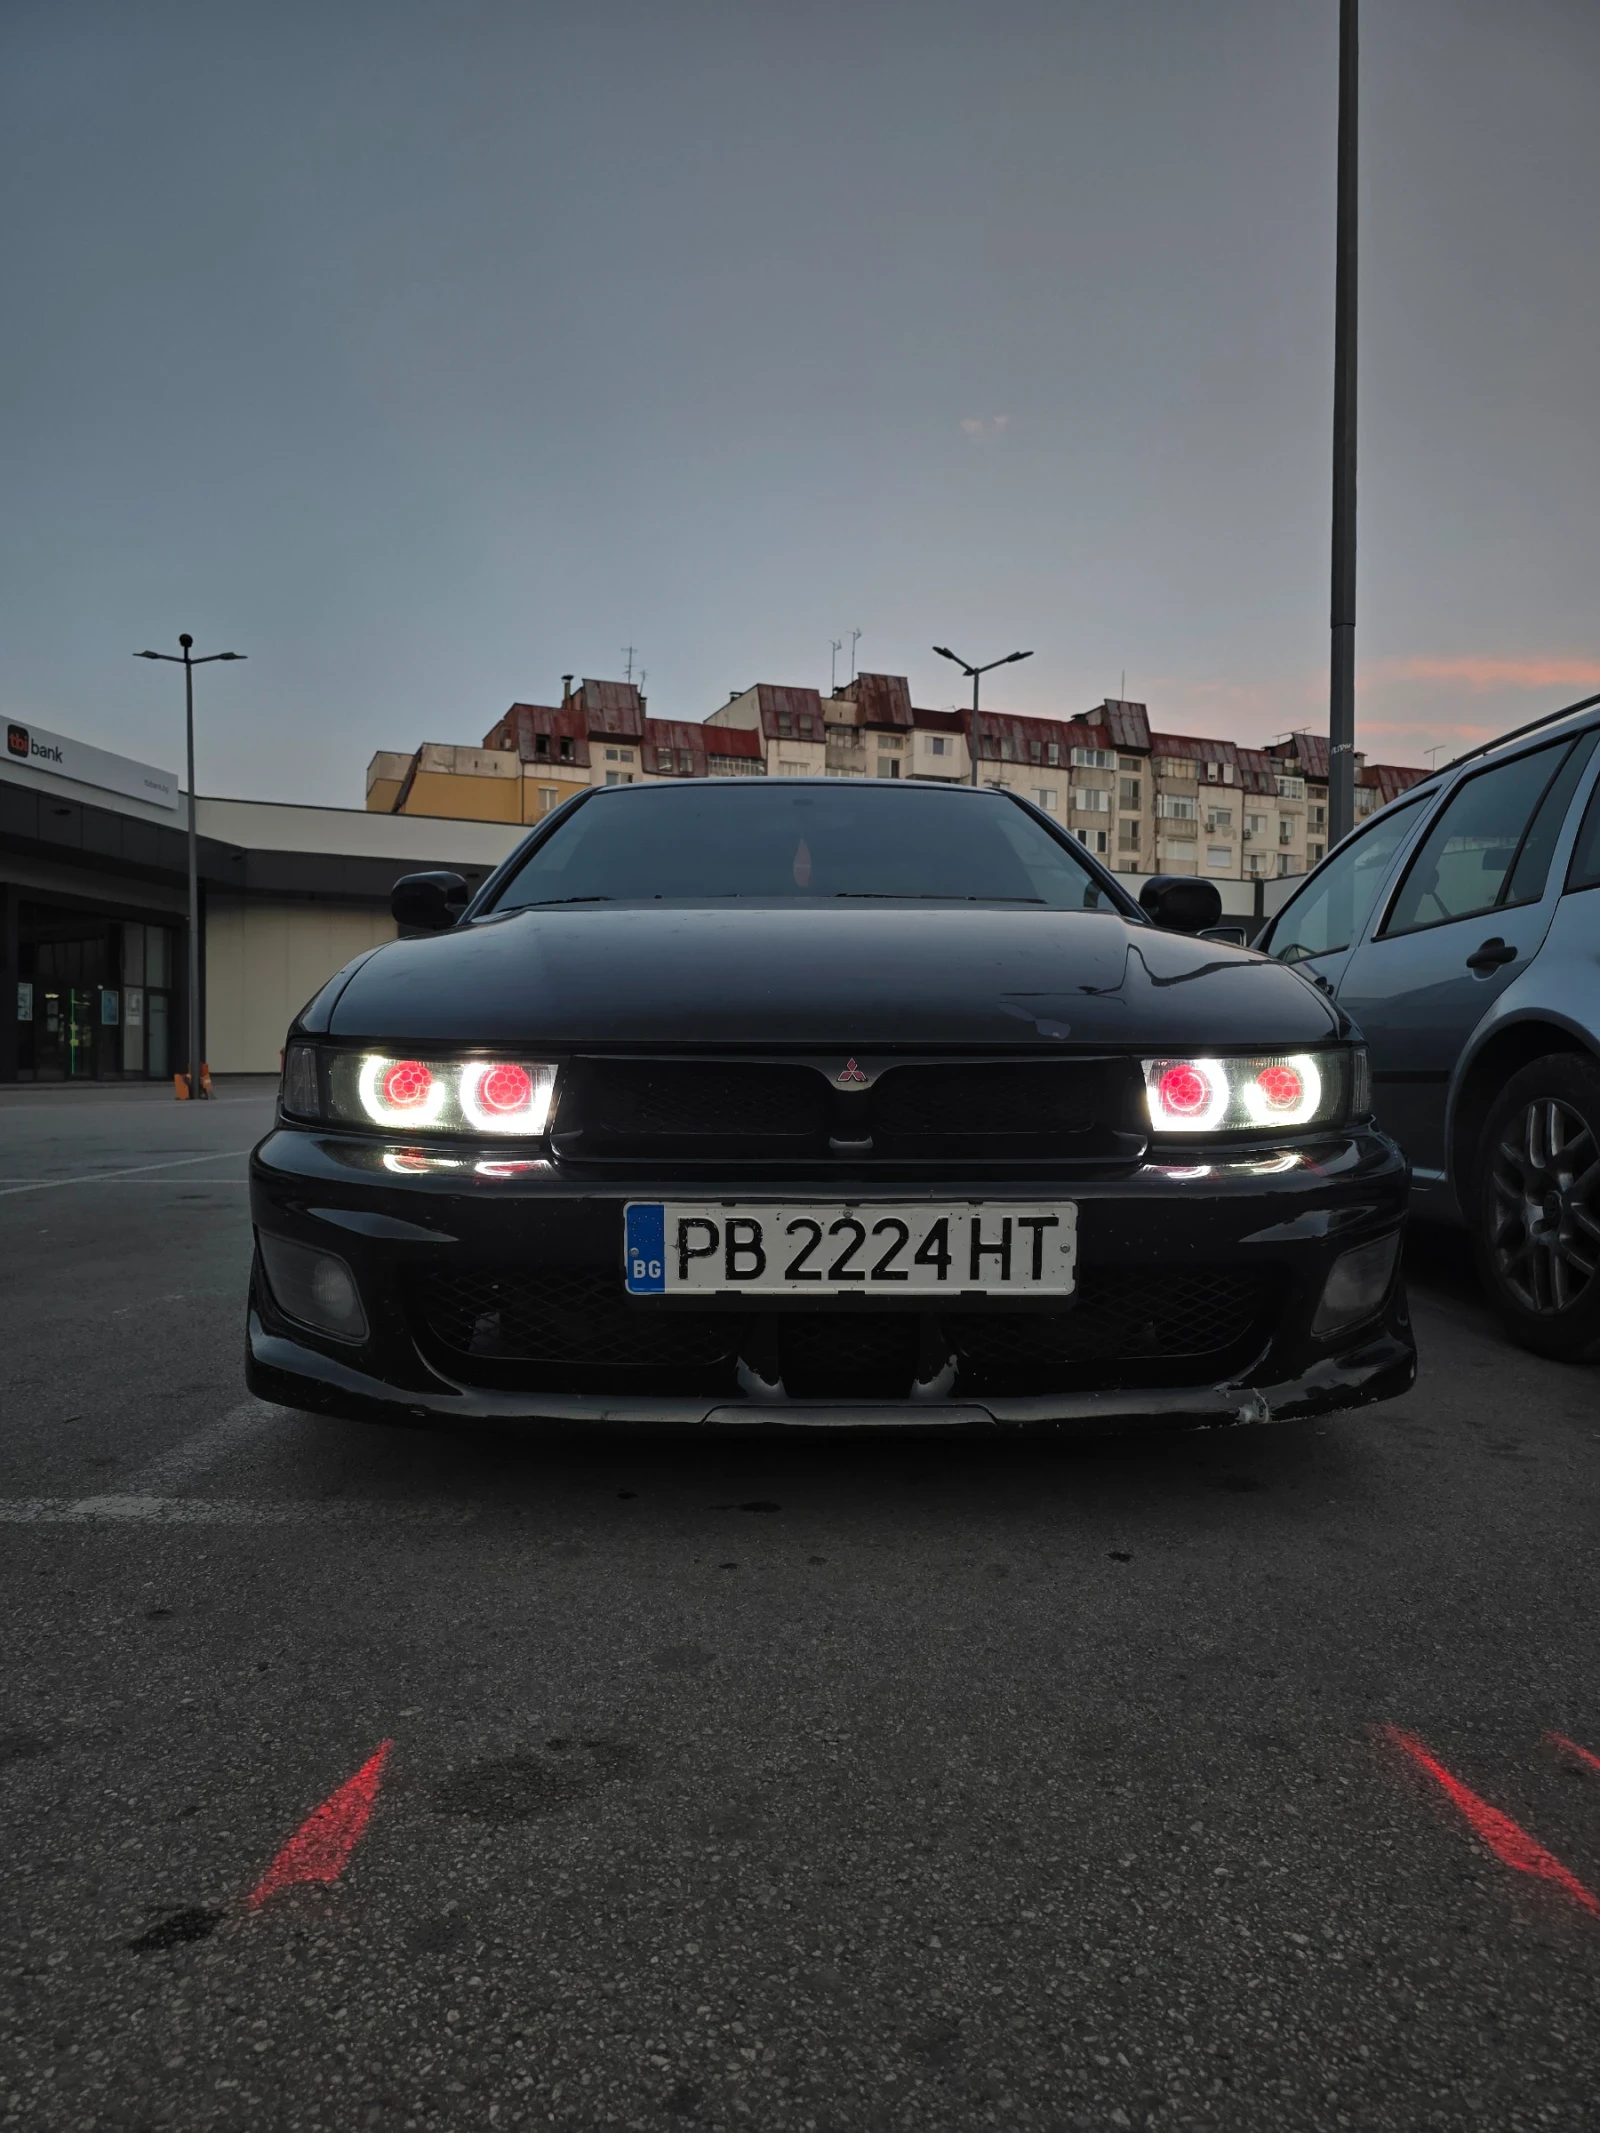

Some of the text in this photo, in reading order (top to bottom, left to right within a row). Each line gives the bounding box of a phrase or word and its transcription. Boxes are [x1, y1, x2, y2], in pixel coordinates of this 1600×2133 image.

[9, 733, 63, 763] tbi bank
[676, 1216, 1059, 1281] PB 2224 HT
[633, 1259, 662, 1279] BG
